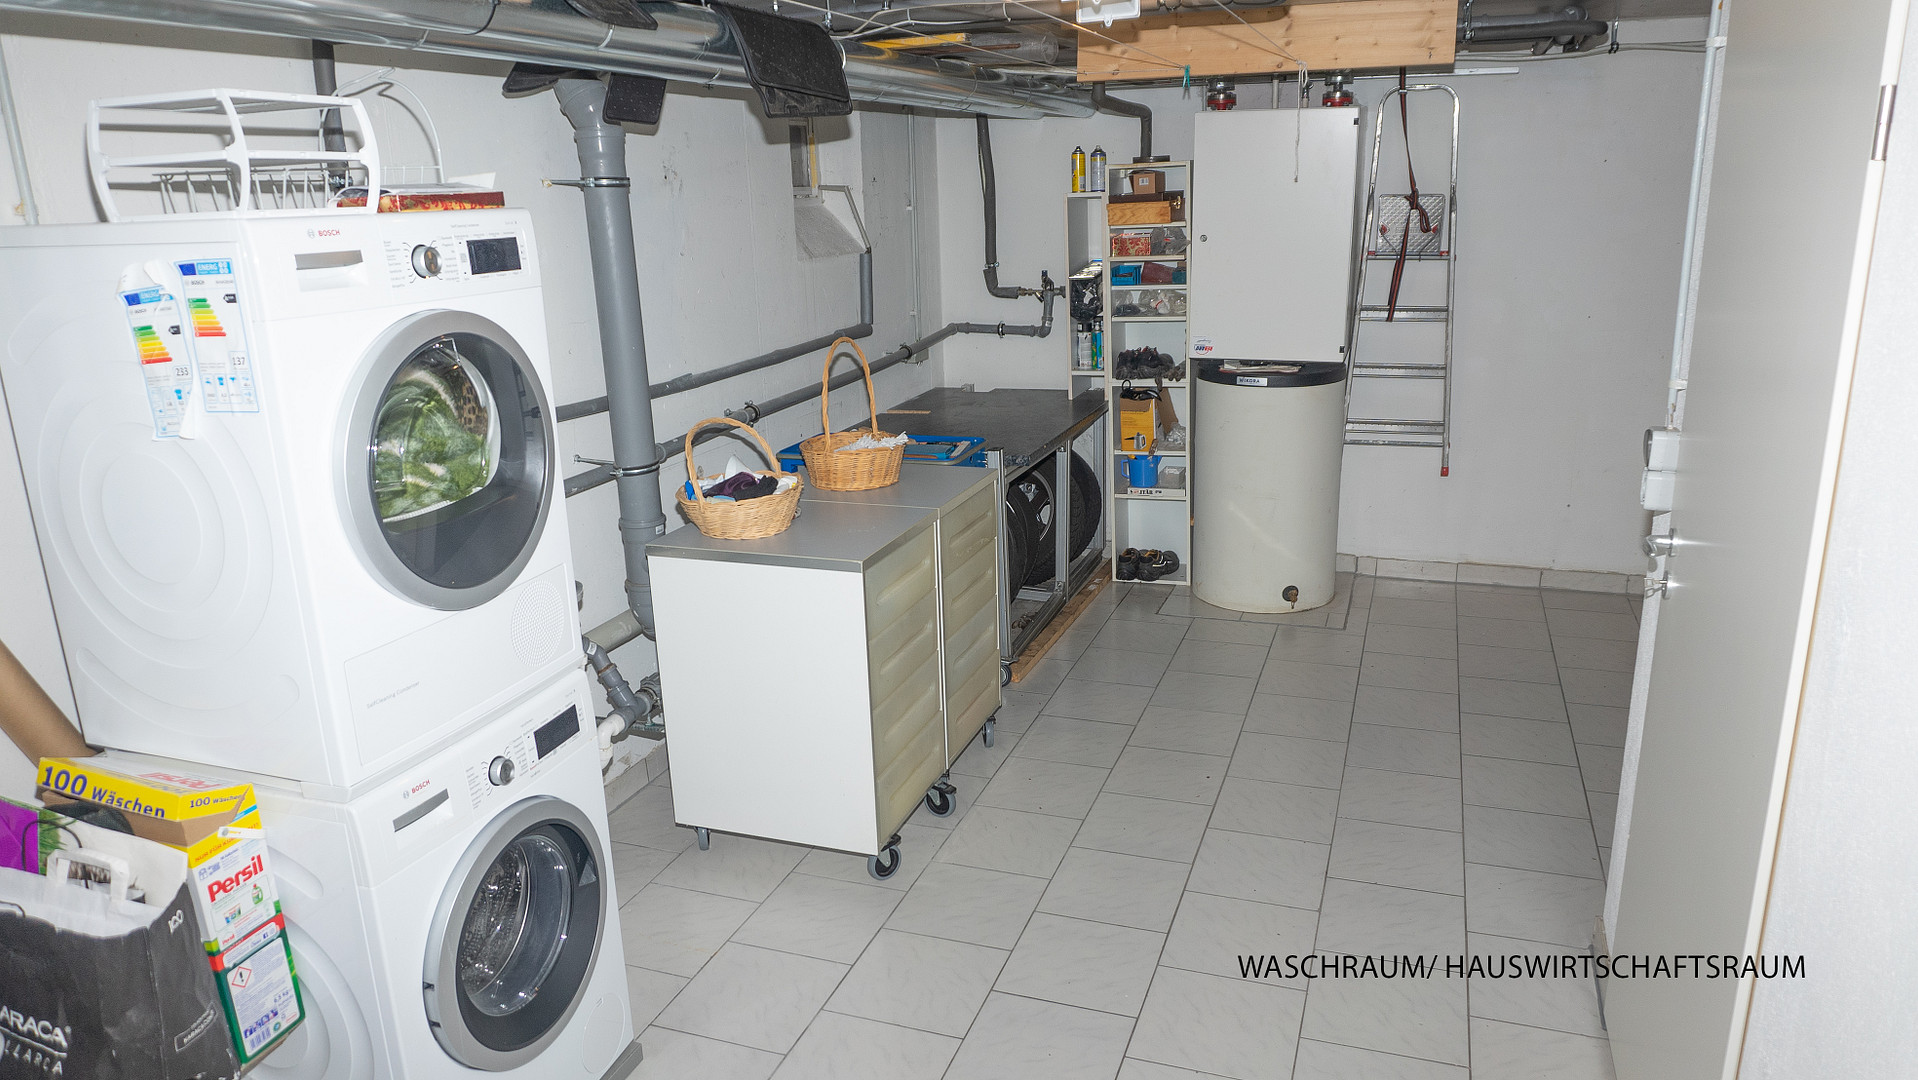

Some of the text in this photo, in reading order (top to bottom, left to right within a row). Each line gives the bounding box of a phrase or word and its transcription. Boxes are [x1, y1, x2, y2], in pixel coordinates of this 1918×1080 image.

[317, 229, 341, 237] BOSCH
[232, 356, 246, 366] 137
[176, 366, 189, 376] 233
[42, 766, 166, 818] 100 Wäschen
[411, 779, 431, 794] BOSCH
[190, 796, 211, 808] 100
[207, 854, 264, 903] Persil
